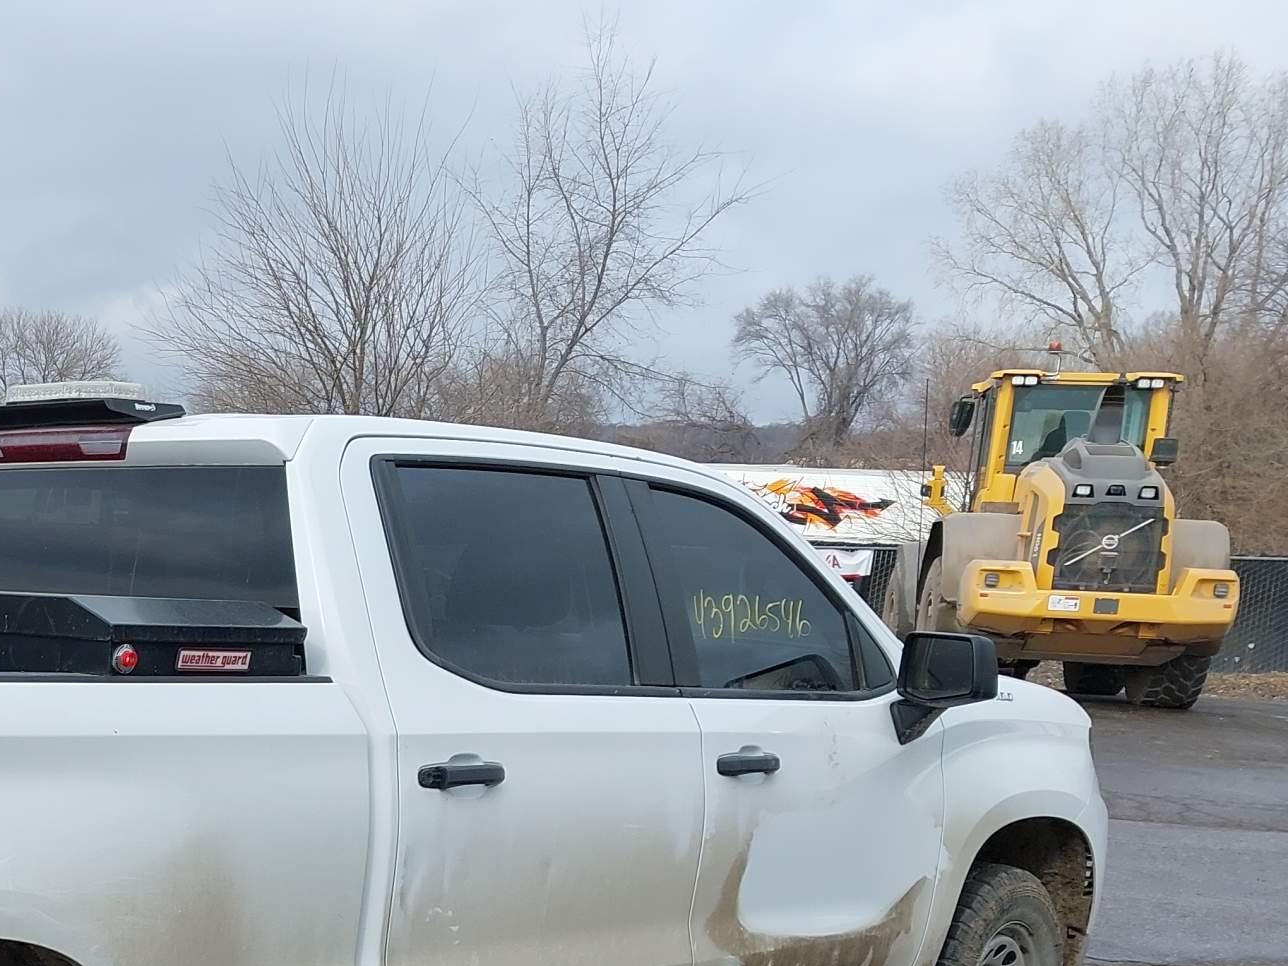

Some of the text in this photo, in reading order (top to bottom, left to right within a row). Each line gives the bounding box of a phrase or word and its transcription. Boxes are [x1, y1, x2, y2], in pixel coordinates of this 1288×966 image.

[1011, 440, 1024, 455] 14
[692, 588, 812, 643] 43926546
[181, 652, 248, 667] weather guard
